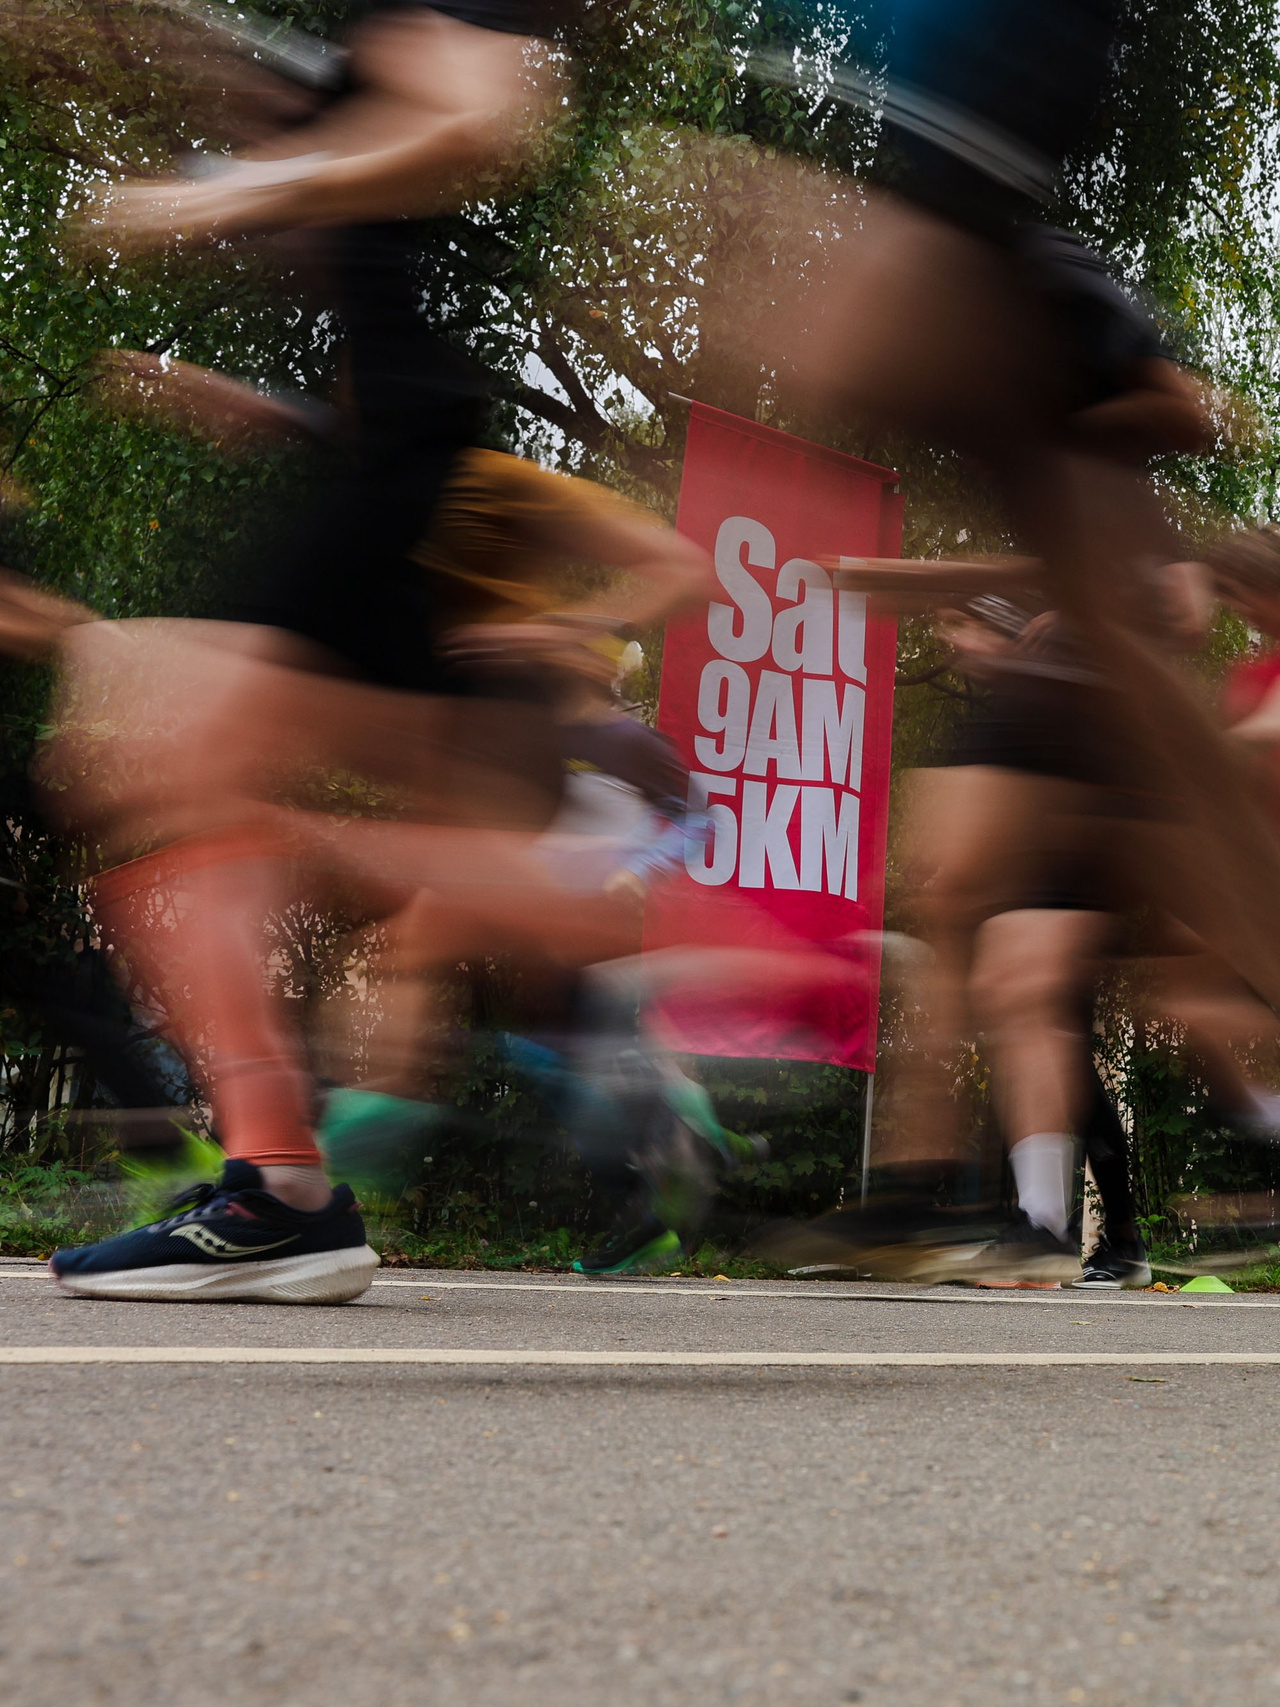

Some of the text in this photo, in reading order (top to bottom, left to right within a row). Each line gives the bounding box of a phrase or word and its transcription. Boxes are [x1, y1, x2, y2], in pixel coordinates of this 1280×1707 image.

[707, 516, 868, 686] Sat
[694, 659, 866, 793] 9AM
[684, 770, 861, 902] 5KM
